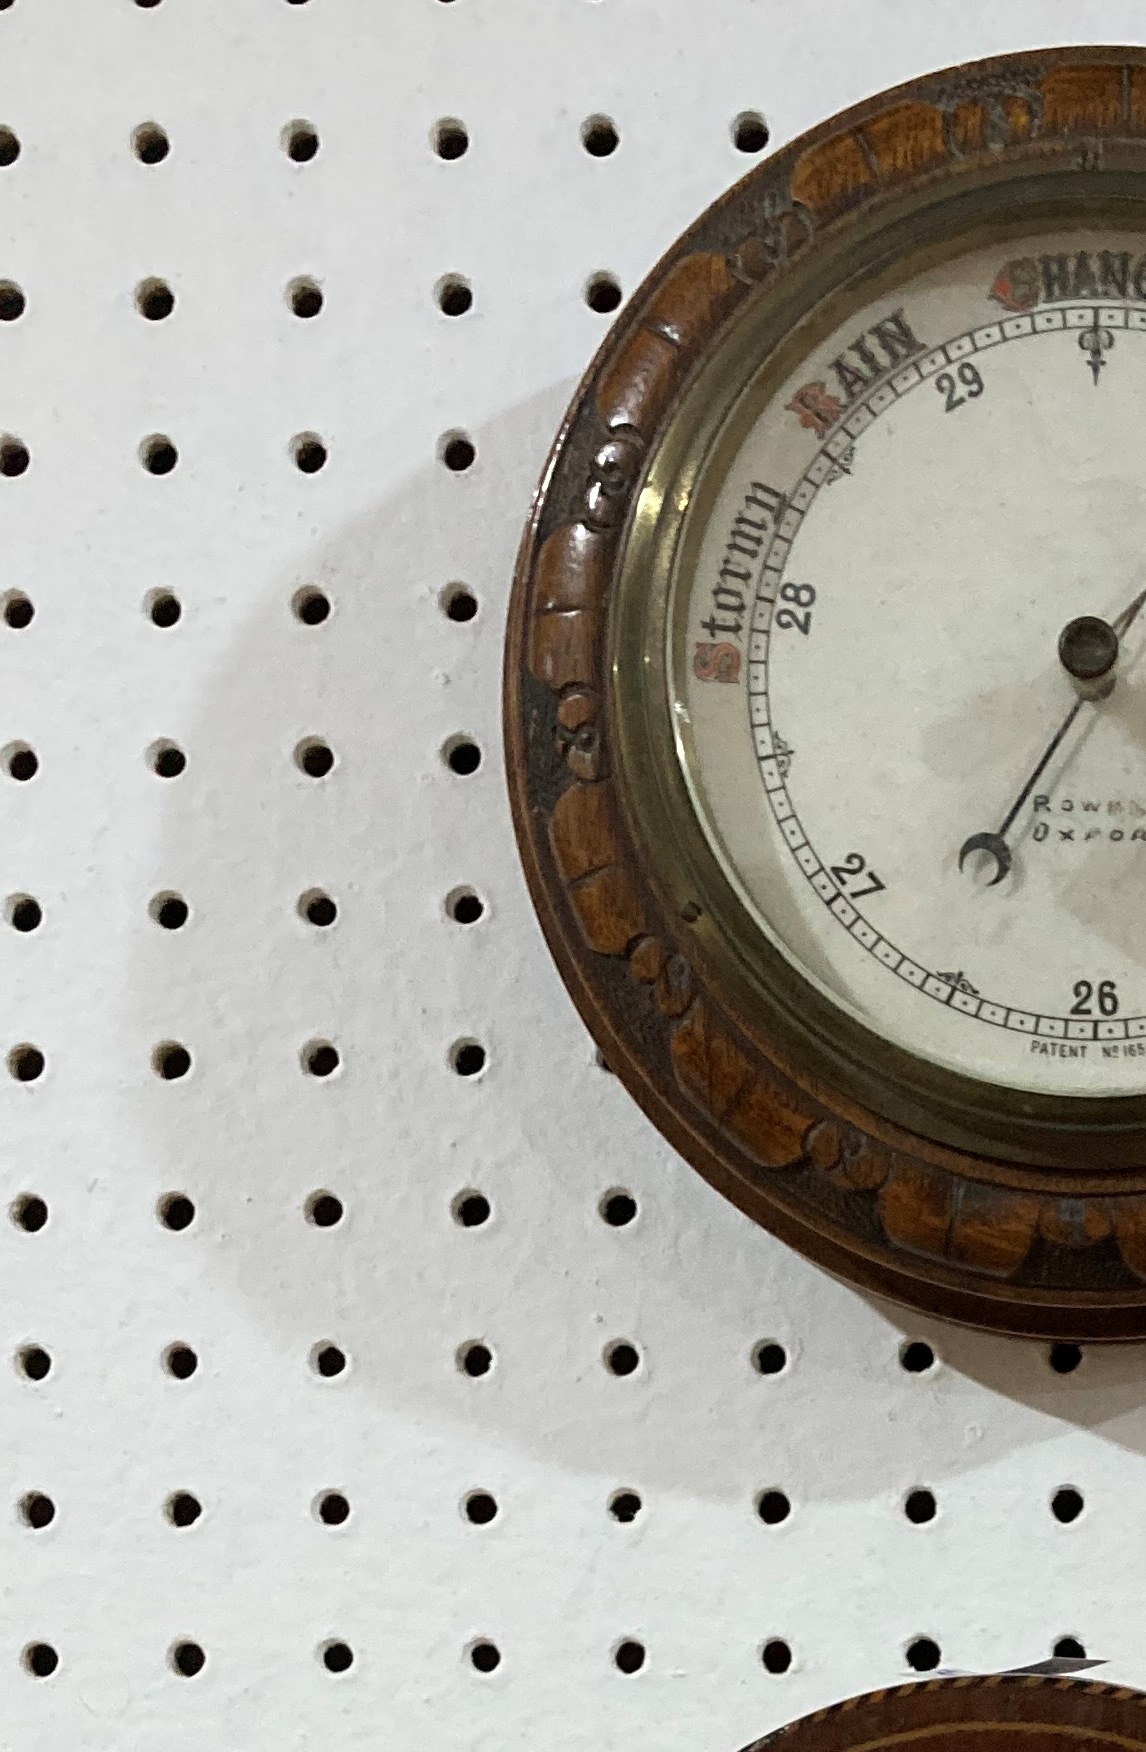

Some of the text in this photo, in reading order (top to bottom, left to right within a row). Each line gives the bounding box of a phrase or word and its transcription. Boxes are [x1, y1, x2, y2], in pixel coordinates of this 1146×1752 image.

[785, 307, 927, 438] RAIN
[935, 362, 985, 413] 29
[776, 582, 817, 635] 28
[830, 852, 887, 900] 27
[1070, 980, 1119, 1017] 26
[1030, 1039, 1087, 1058] PATENT
